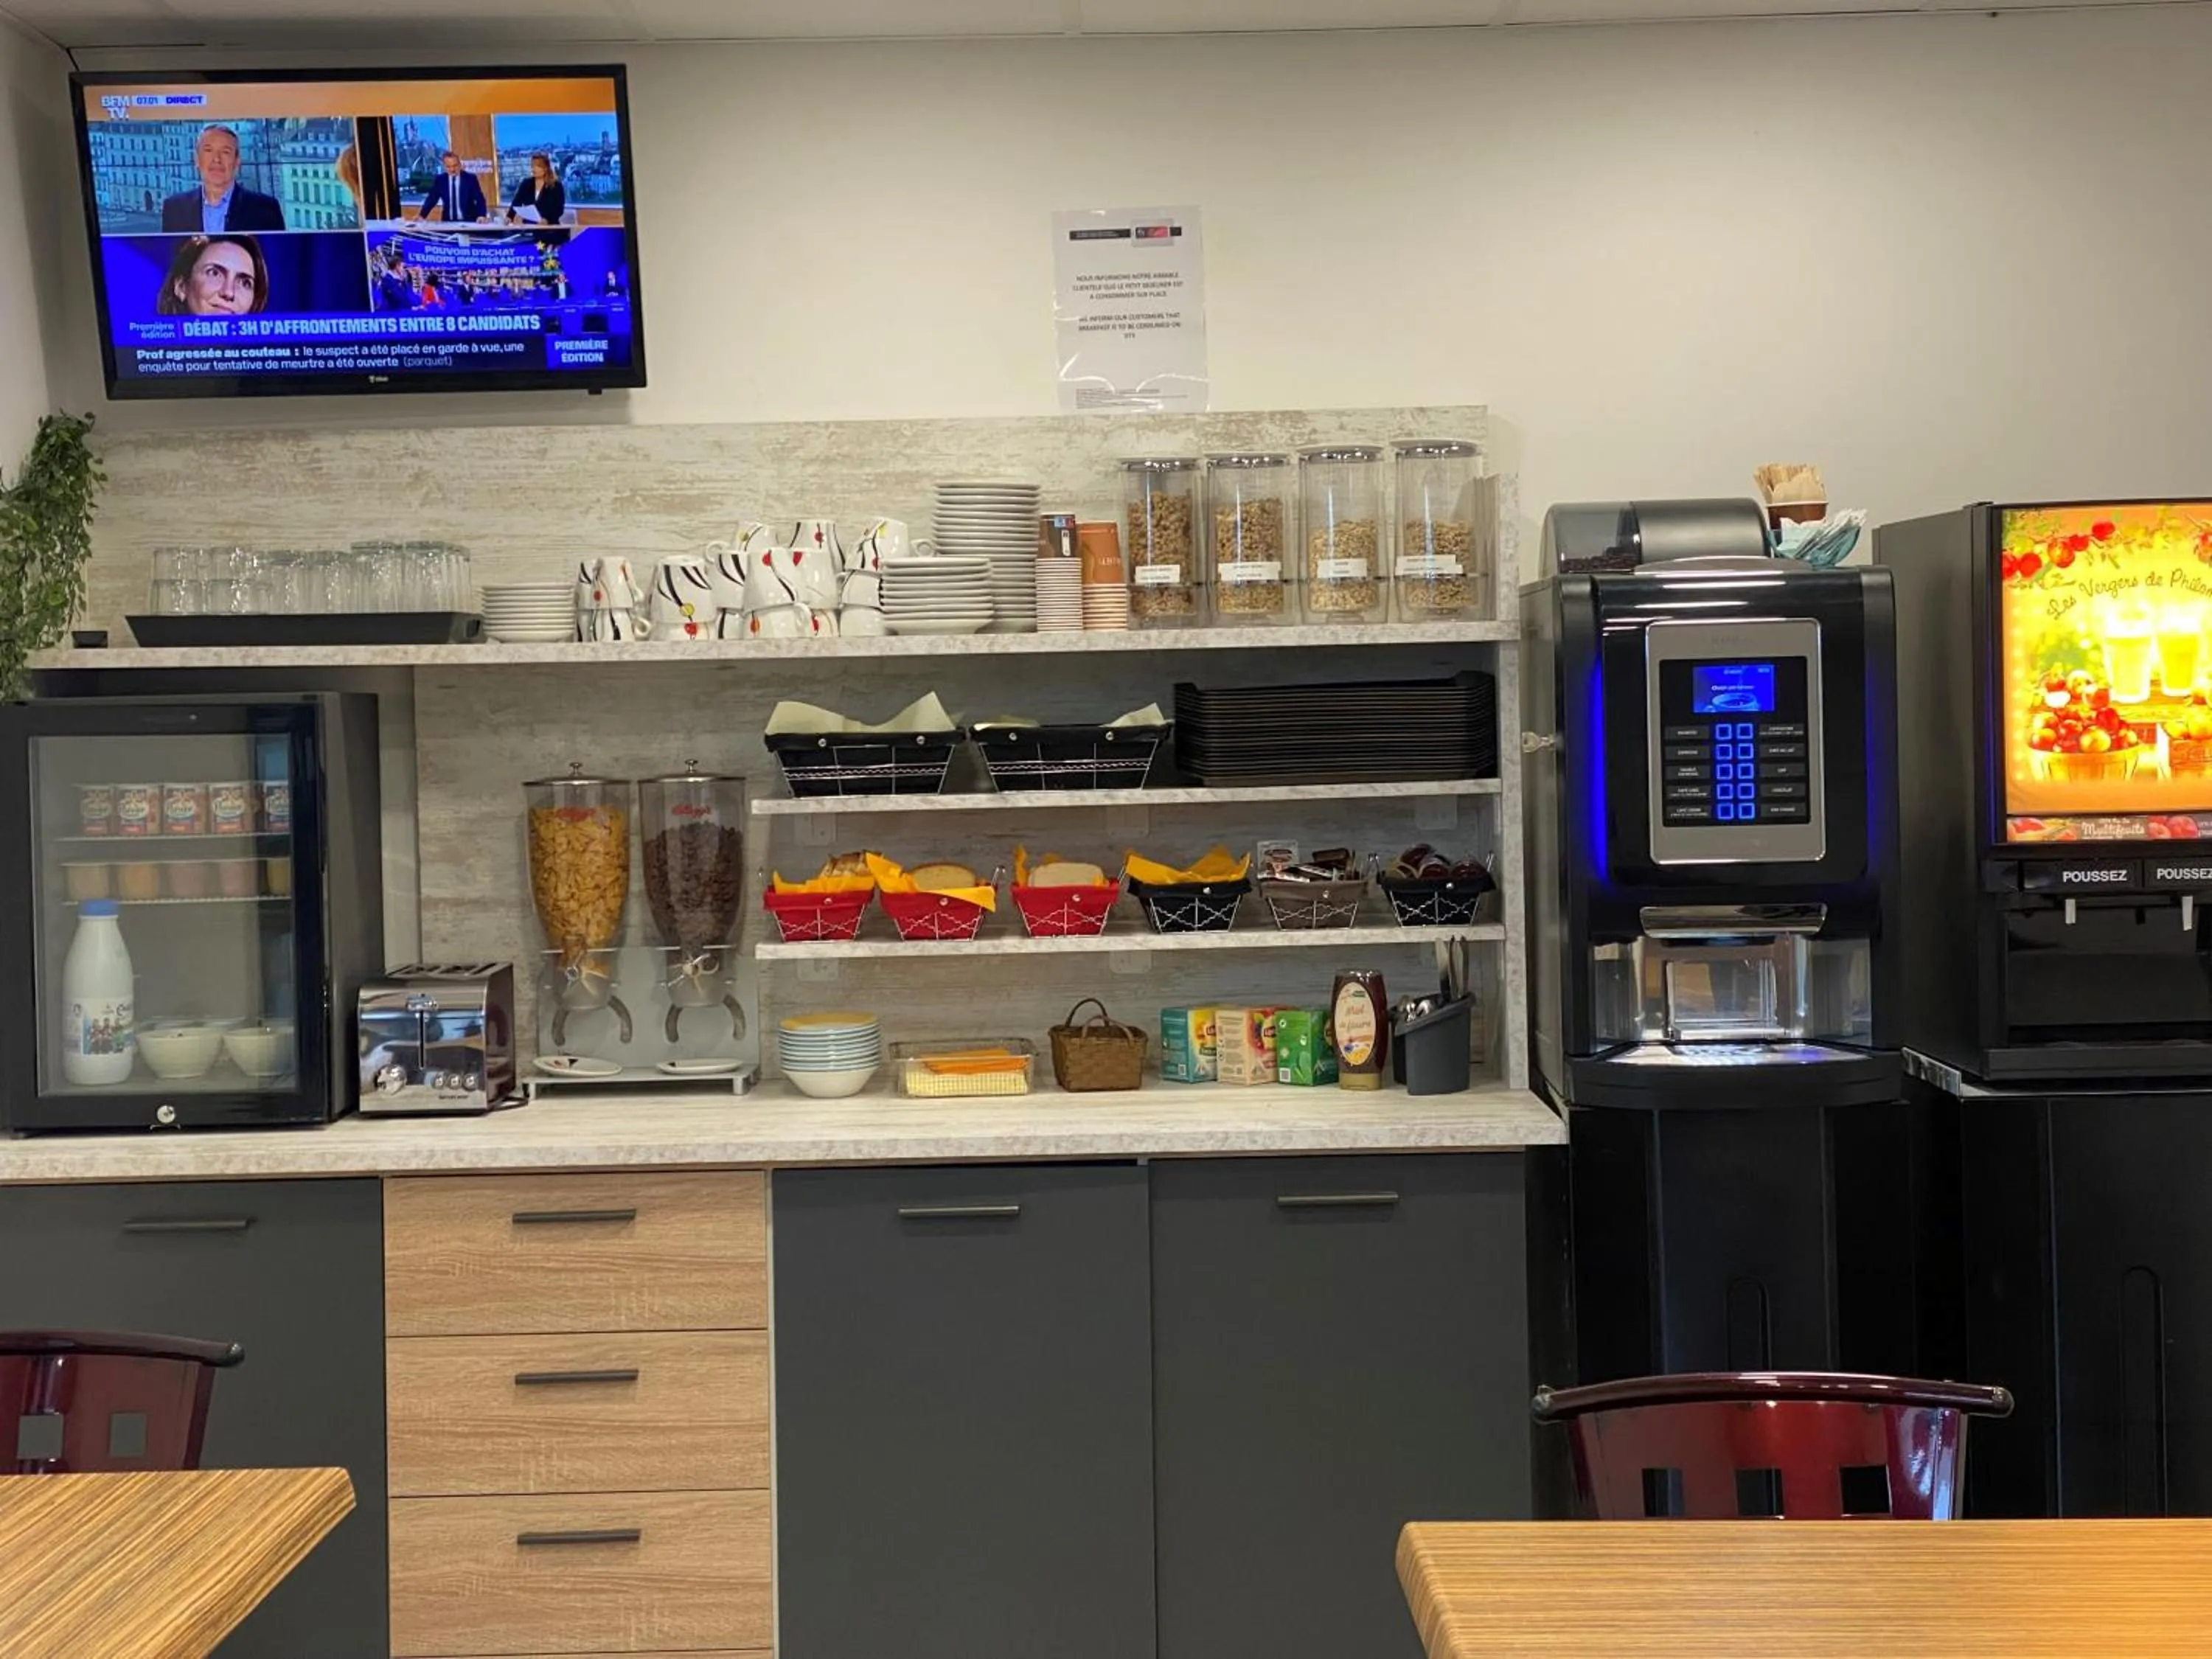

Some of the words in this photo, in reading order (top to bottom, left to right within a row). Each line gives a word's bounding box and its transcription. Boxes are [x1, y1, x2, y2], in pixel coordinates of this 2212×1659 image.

[166, 95, 204, 105] DIRECT
[184, 319, 229, 337] DÉBAT
[239, 320, 258, 336] 3H
[260, 317, 397, 336] D'AFFRONTEMENTS
[400, 317, 444, 332] ENTRE
[445, 316, 455, 331] 8
[457, 315, 540, 331] CANDIDATS
[554, 338, 608, 350] PREMIÈRE
[136, 349, 166, 360] Prof
[168, 349, 222, 361] agressée
[224, 350, 239, 358] au
[241, 348, 291, 358] couteau
[303, 347, 313, 355] le
[316, 346, 359, 358] suspect
[371, 344, 389, 355] été
[391, 344, 421, 356] placé
[423, 346, 436, 354] en
[438, 343, 469, 355] garde
[471, 344, 479, 352] à
[561, 351, 604, 363] ÉDITION
[138, 361, 184, 373] enquête
[186, 362, 210, 372] pour
[214, 359, 263, 370] tentative
[265, 359, 279, 369] de
[281, 359, 325, 369] meurtre
[336, 358, 354, 367] été
[356, 356, 398, 366] ouverte
[403, 355, 453, 367] (parquet)
[2078, 575, 2139, 599] Vergers
[2145, 571, 2163, 586] de
[2062, 869, 2127, 883] POUSSEZ
[2157, 867, 2212, 880] POUSSEZ
